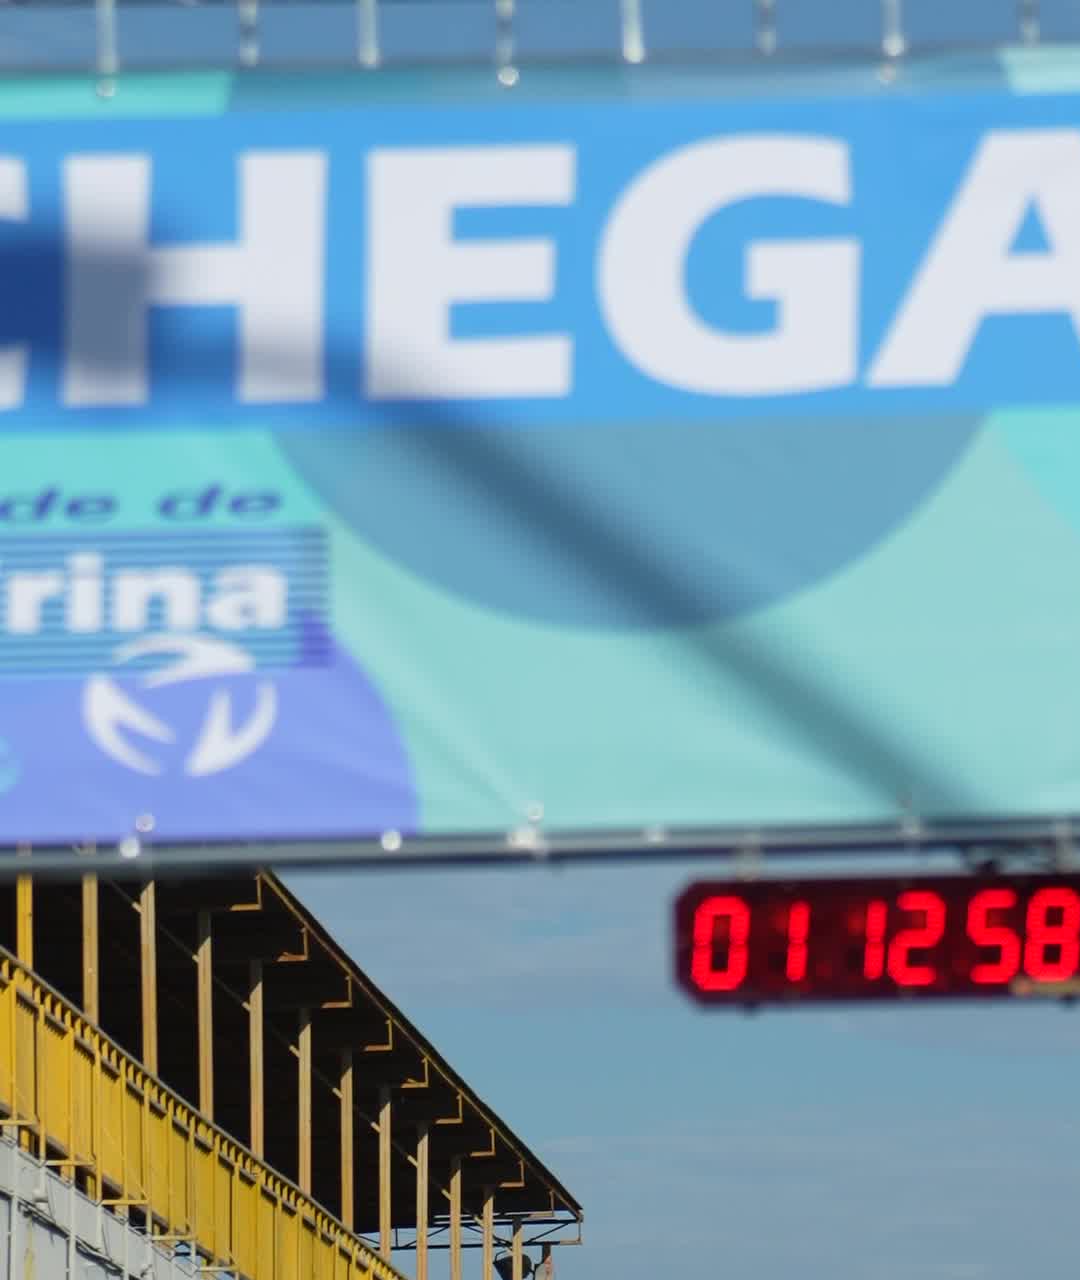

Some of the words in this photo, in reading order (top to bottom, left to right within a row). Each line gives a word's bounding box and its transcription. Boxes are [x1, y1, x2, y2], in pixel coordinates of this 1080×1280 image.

[155, 482, 282, 524] de
[691, 895, 811, 991] 01
[863, 890, 947, 987] 12
